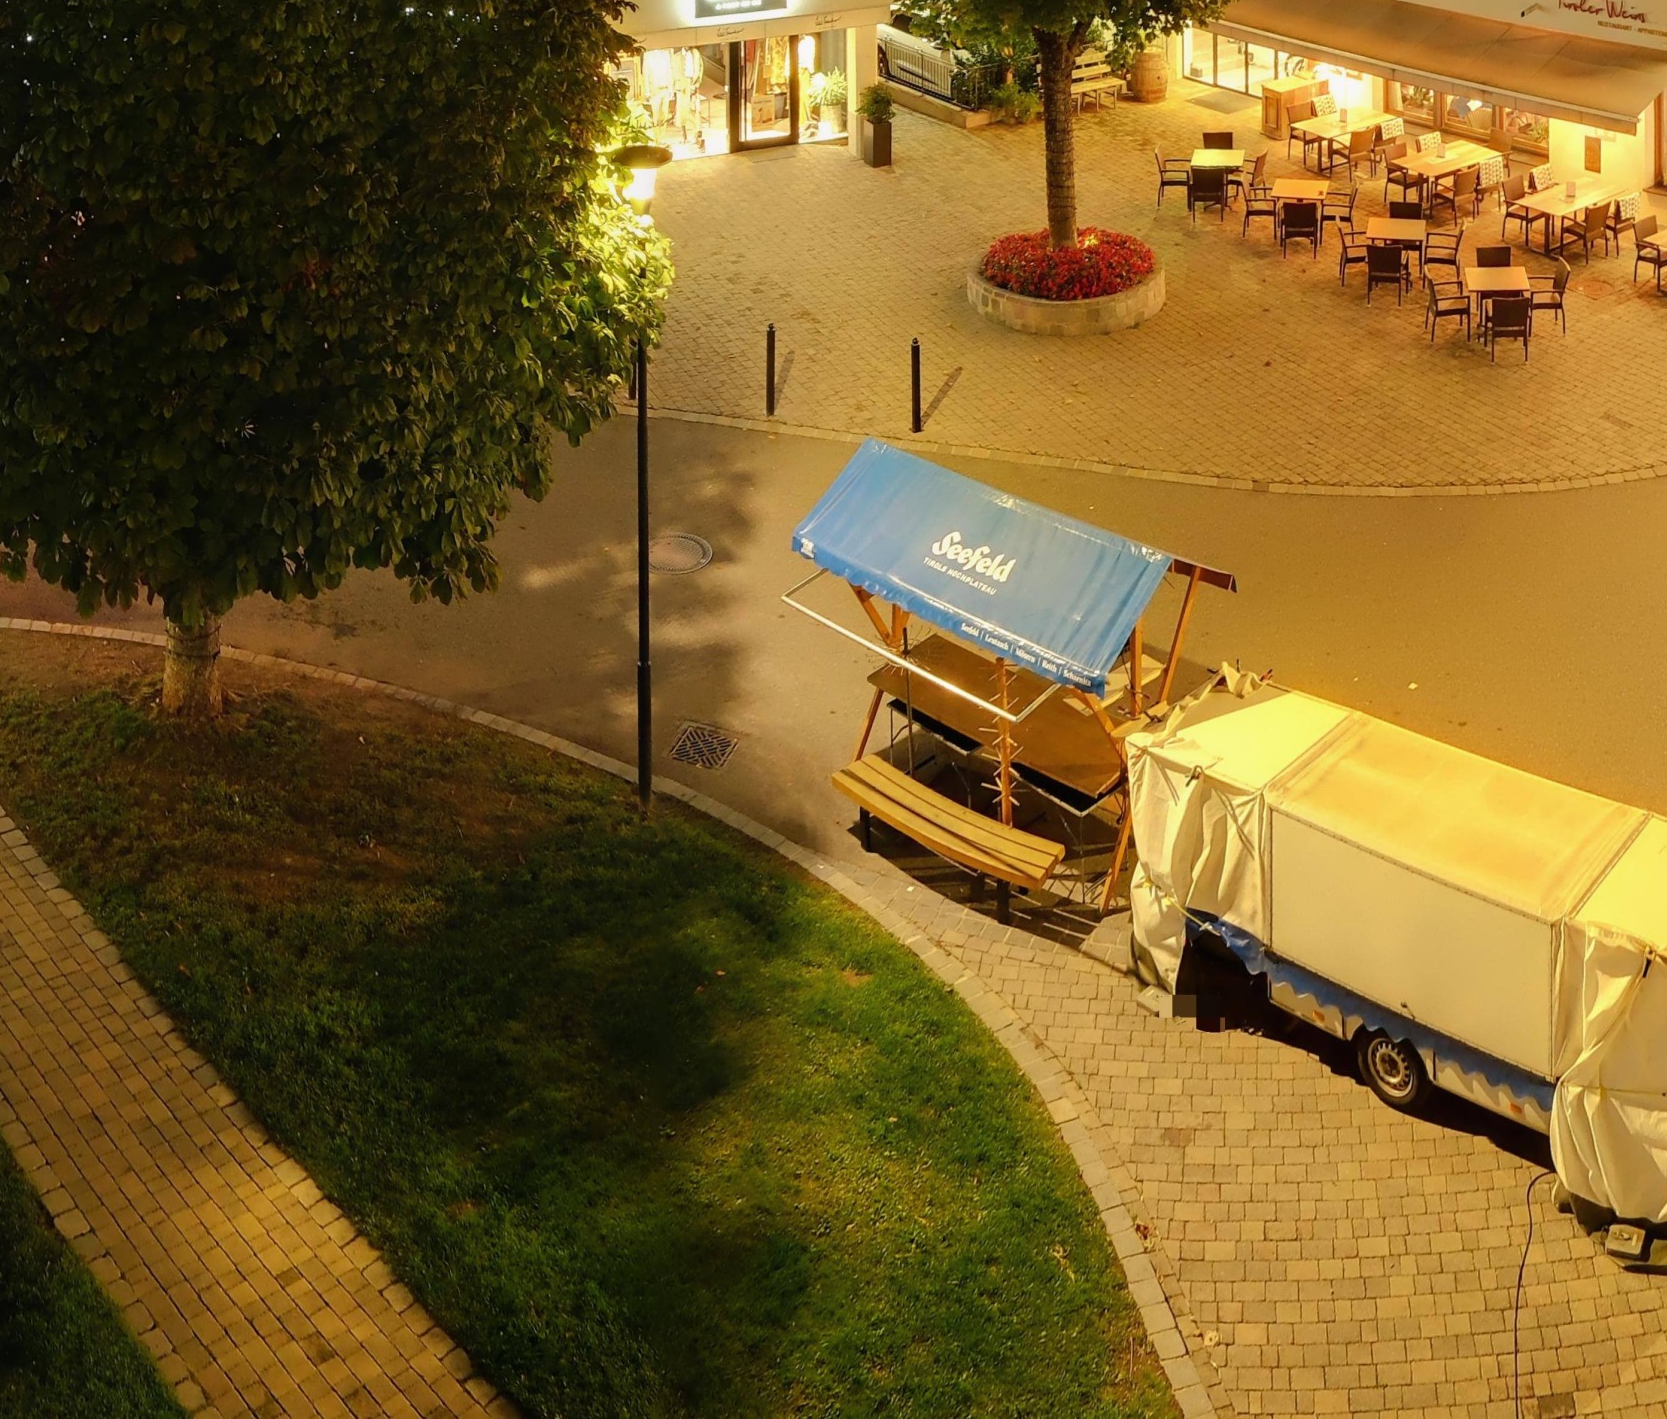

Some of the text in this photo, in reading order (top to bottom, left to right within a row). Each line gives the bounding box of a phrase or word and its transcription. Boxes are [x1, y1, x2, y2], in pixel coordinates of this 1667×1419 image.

[923, 555, 998, 596] TIROLS HOCHPLATEAU
[931, 530, 1017, 583] Seefeld
